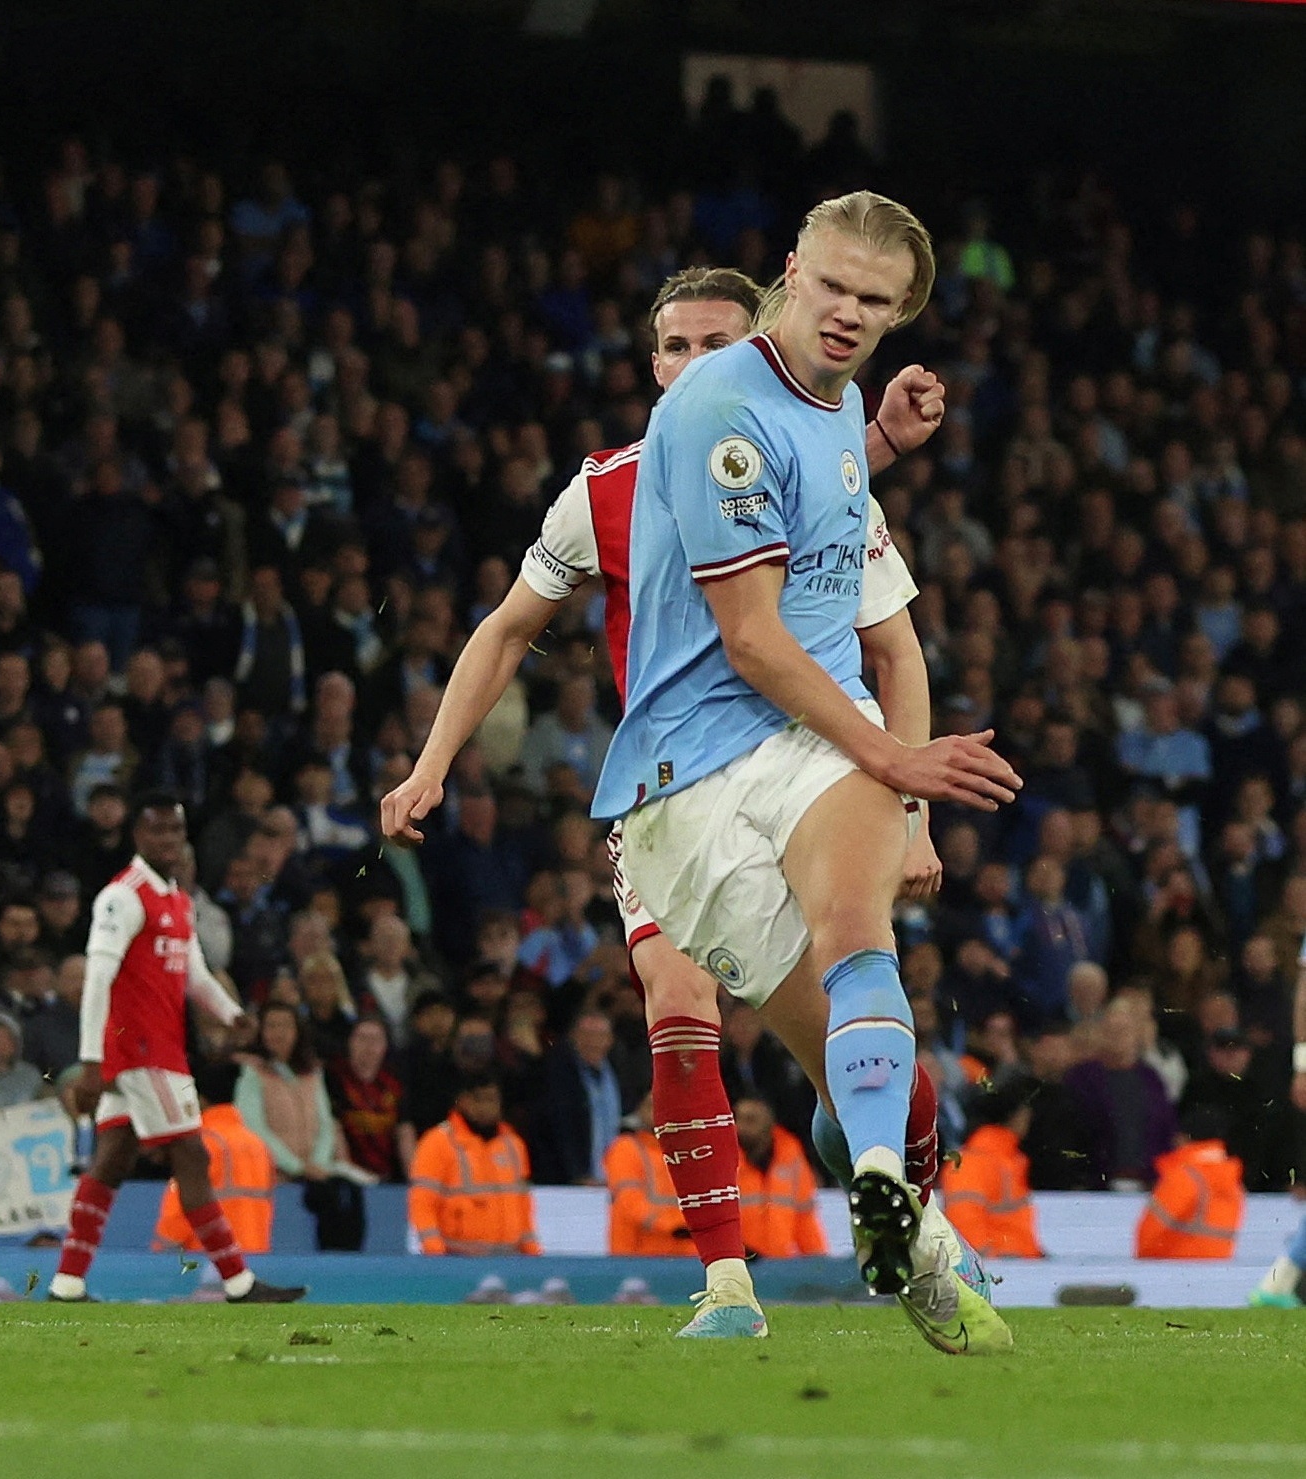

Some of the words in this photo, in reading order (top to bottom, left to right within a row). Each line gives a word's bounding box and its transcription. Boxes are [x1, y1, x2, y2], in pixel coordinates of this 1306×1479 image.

[718, 498, 736, 511] No
[845, 1057, 900, 1073] CITY
[662, 1144, 714, 1166] AFC
